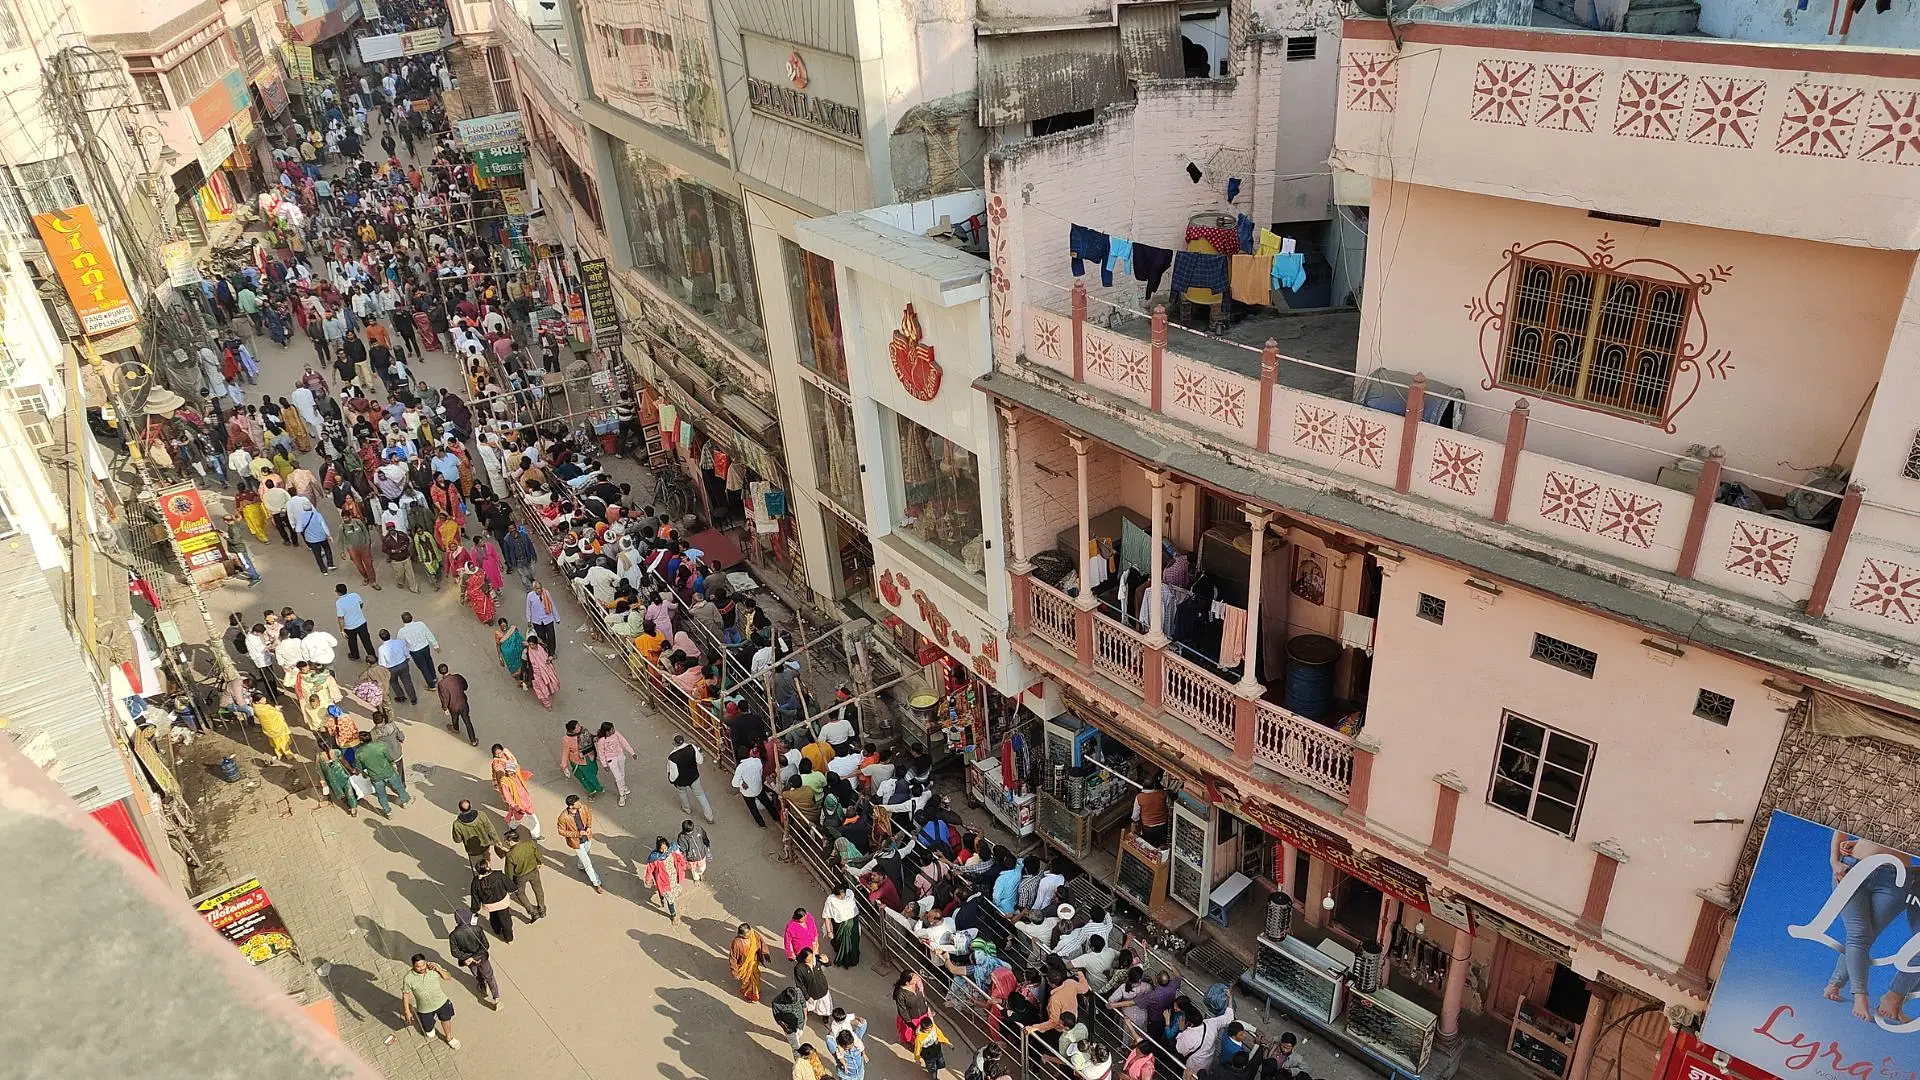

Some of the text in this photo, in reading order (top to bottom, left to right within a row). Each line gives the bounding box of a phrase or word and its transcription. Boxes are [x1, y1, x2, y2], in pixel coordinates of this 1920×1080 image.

[52, 213, 107, 302] Cinni
[84, 314, 104, 324] FANS
[107, 306, 131, 318] PUMPS
[89, 314, 134, 331] APPLIANCES
[173, 516, 210, 535] Adinath
[212, 915, 234, 928] Café
[1753, 1005, 1874, 1080] Lyra
